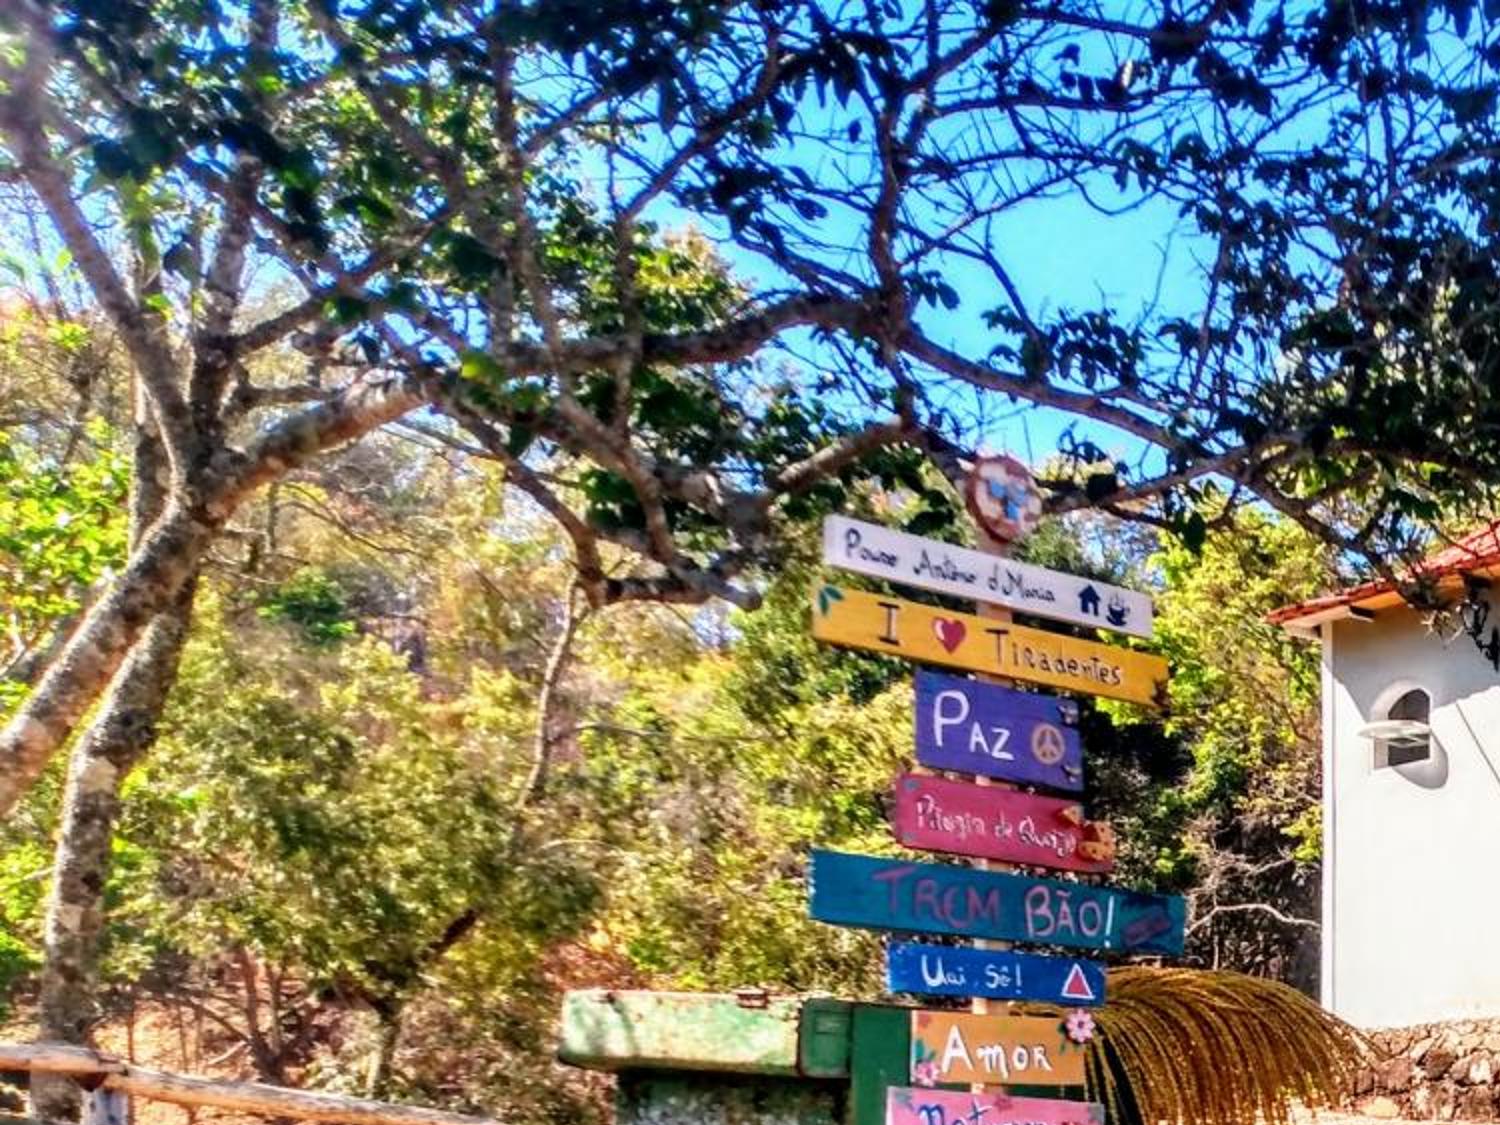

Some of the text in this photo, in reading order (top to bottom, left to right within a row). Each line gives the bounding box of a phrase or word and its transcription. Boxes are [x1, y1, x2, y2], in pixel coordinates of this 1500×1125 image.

[877, 601, 901, 646] I
[994, 809, 1013, 839] de
[1024, 885, 1115, 948] BÃO!
